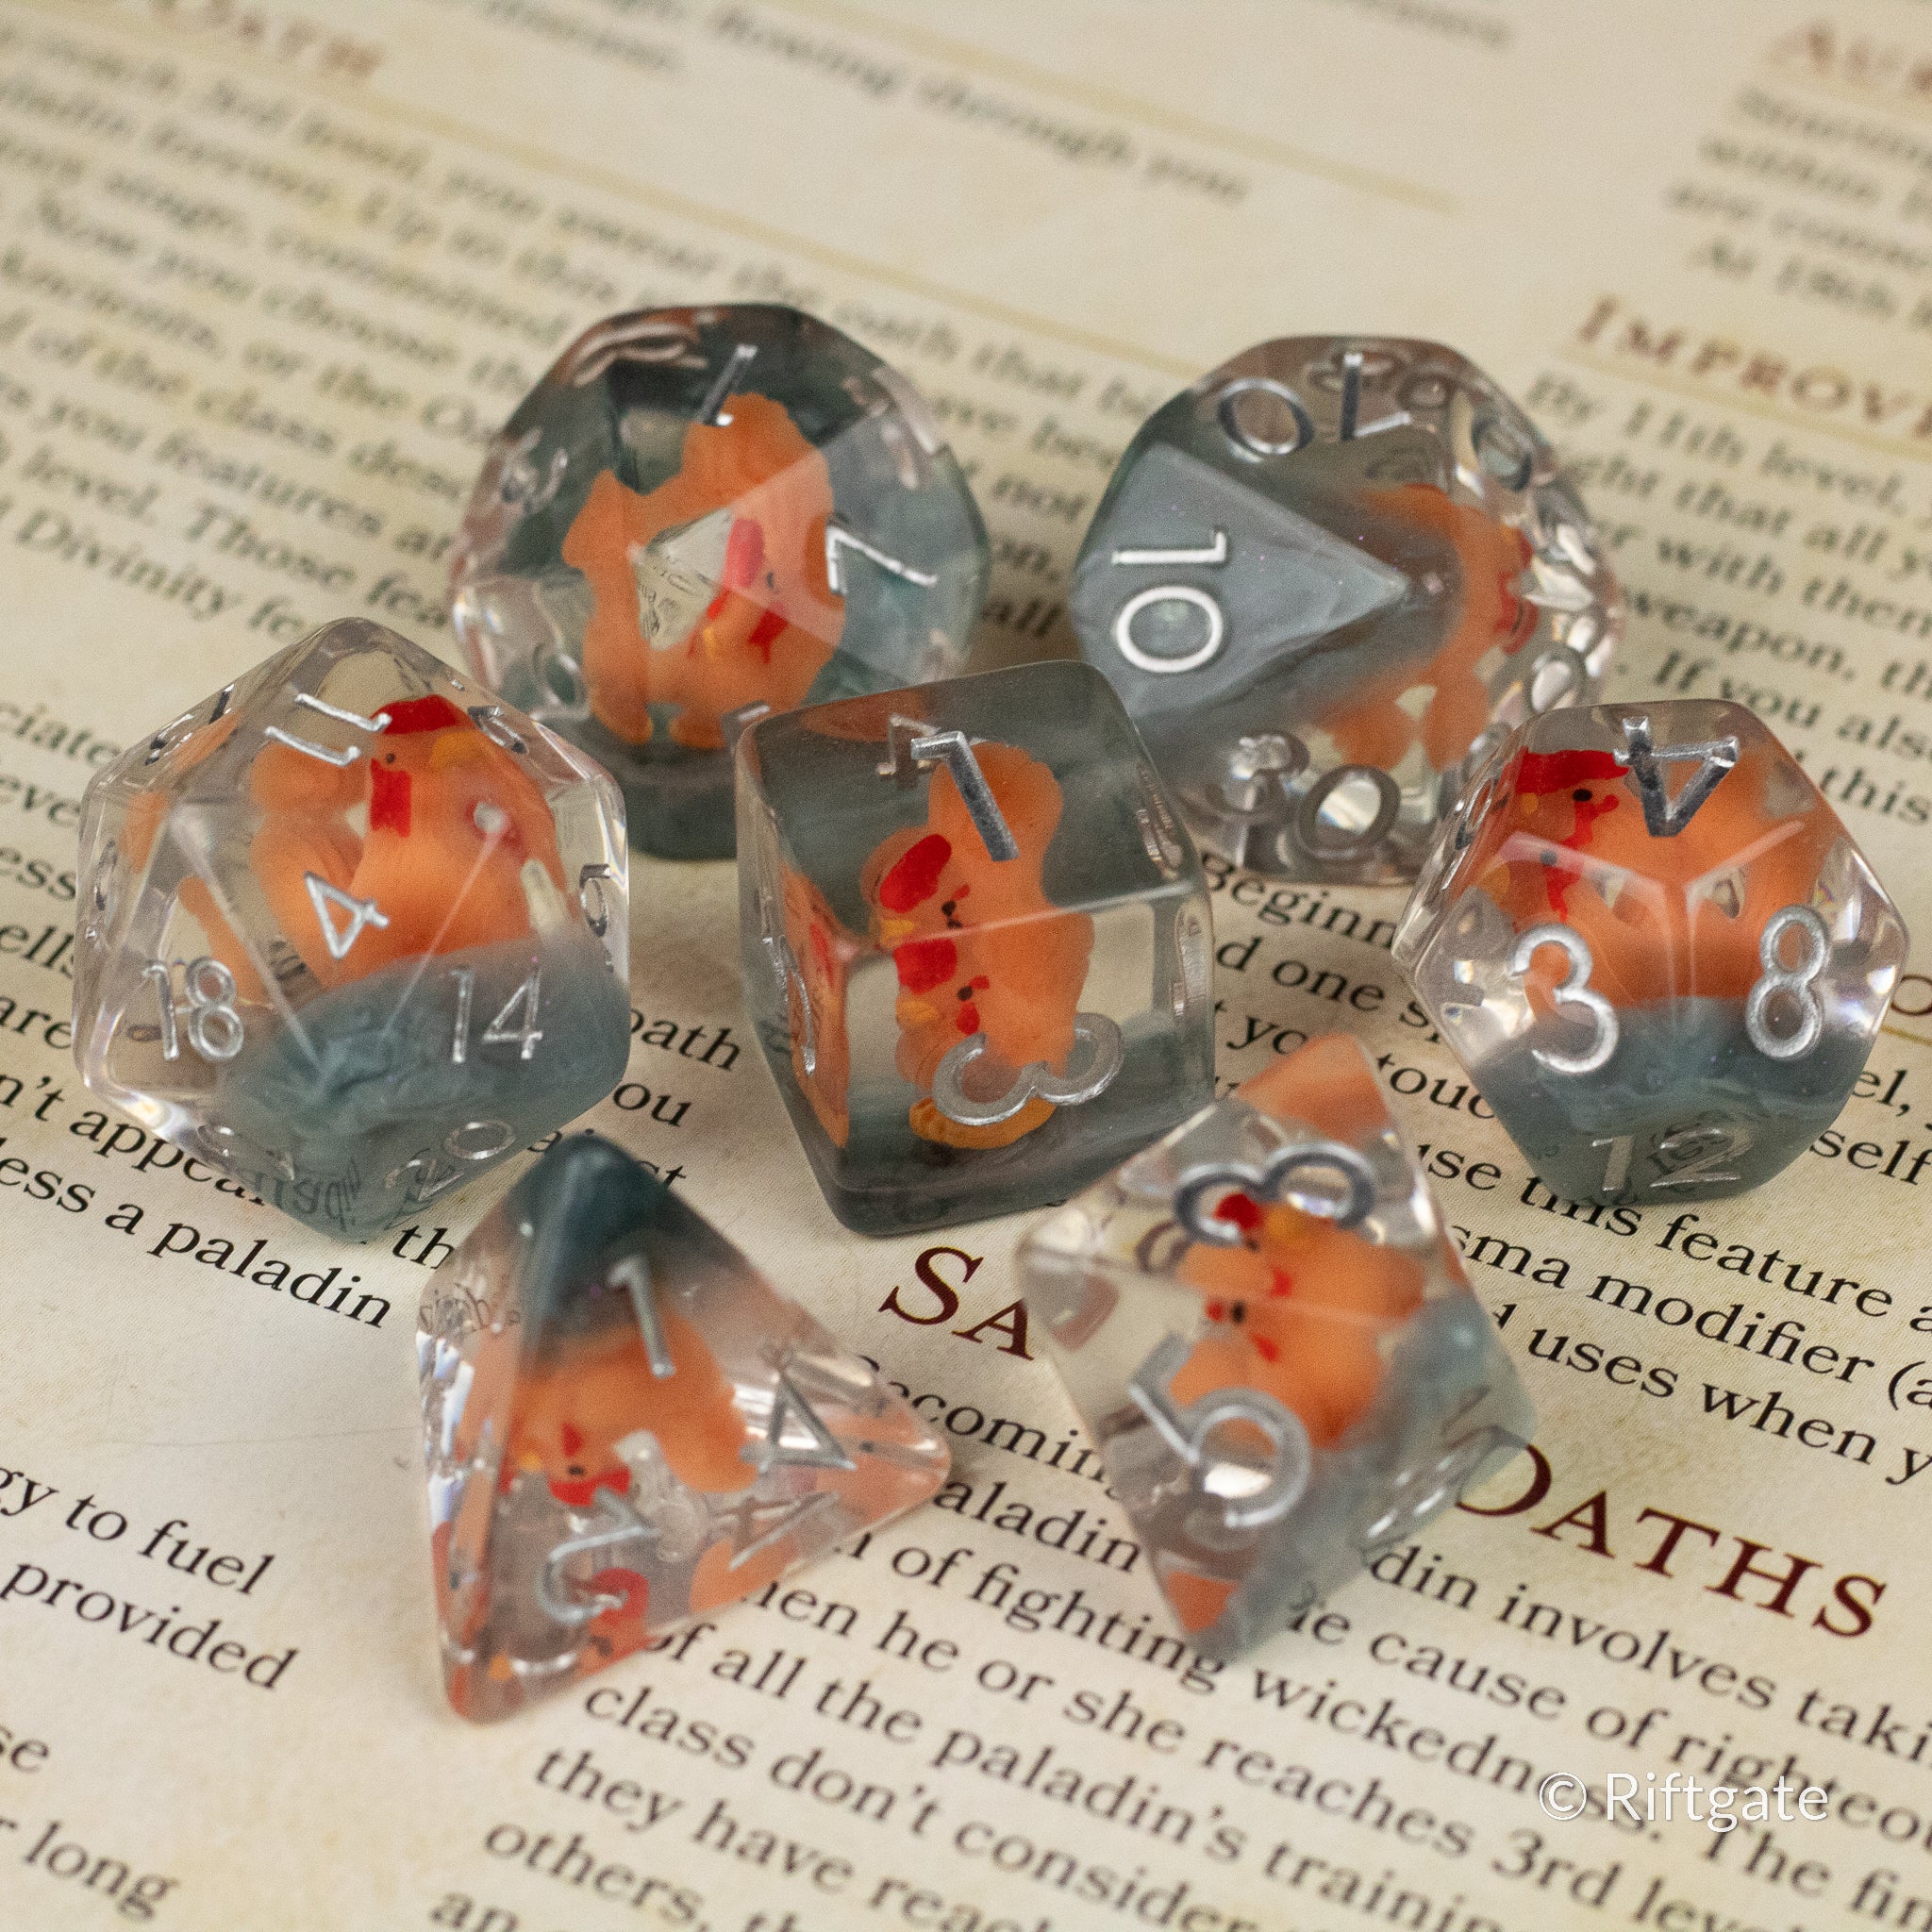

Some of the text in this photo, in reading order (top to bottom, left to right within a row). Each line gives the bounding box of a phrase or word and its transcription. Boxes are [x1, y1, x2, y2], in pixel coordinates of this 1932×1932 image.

[13, 508, 242, 623] Divinity
[824, 521, 941, 608] 7
[1110, 526, 1228, 674] 10
[1612, 715, 1740, 838] 4
[304, 868, 391, 959] 4
[143, 956, 245, 1060] 18
[451, 957, 544, 1063] 14
[1226, 1016, 1309, 1057] yo
[1271, 958, 1385, 1013] one
[1509, 921, 1620, 1074] 3
[1743, 903, 1835, 1062] 8
[612, 1082, 692, 1128] ou
[930, 1012, 1124, 1126] 3
[1174, 1140, 1377, 1245] 3
[1591, 1126, 1756, 1194] 12
[104, 1201, 145, 1236] a
[146, 1222, 392, 1329] paladin
[391, 1224, 457, 1271] th
[1656, 1213, 1894, 1319] feature
[607, 1257, 678, 1380] 1
[1586, 1274, 1876, 1385] modifier
[1527, 1325, 1682, 1399] uses
[1702, 1381, 1877, 1466] when
[65, 1493, 128, 1541] to
[138, 1519, 276, 1596] fuel
[0, 1562, 300, 1691] provided
[891, 1545, 974, 1589] of
[965, 1559, 1227, 1696] fighting
[932, 1480, 1141, 1573] aladin
[1368, 1629, 1569, 1723] cause
[1584, 1705, 1671, 1751] of
[1496, 1583, 1778, 1711] involves
[583, 1683, 758, 1772] class
[767, 1744, 944, 1838] don't
[709, 1647, 808, 1701] all
[813, 1678, 924, 1746] the
[929, 1727, 1250, 1864] paladin's
[874, 1608, 961, 1674] he
[975, 1657, 1057, 1703] or
[1060, 1688, 1187, 1755] she
[1199, 1737, 1476, 1859] reaches
[1489, 1825, 1624, 1910] 3rd
[23, 1819, 182, 1924] long
[482, 1822, 713, 1932] others,
[534, 1748, 854, 1895] they have
